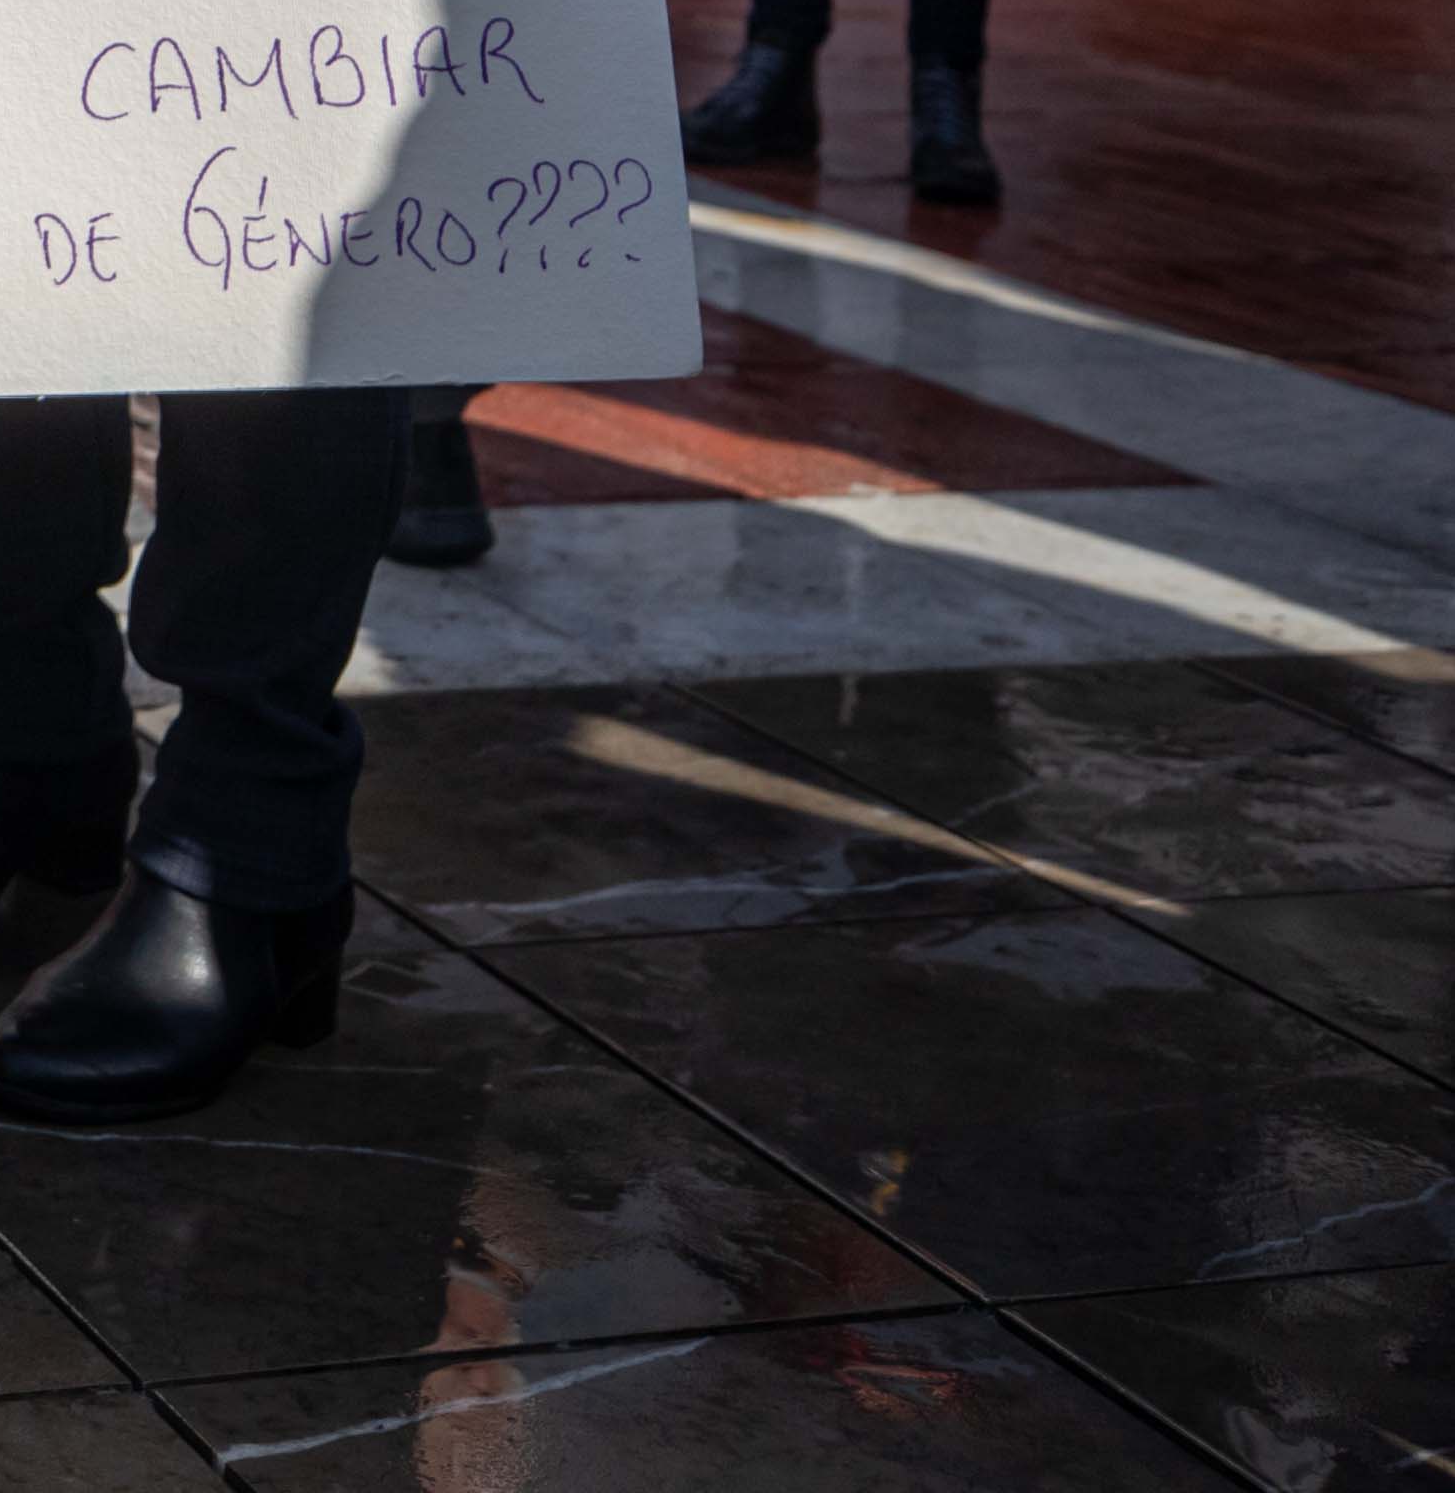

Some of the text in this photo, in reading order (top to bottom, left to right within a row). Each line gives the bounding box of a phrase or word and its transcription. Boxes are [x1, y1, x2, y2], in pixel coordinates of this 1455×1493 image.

[80, 16, 545, 121] CAMBIAR
[34, 211, 123, 287] DE
[182, 145, 653, 290] GÉNERO????
